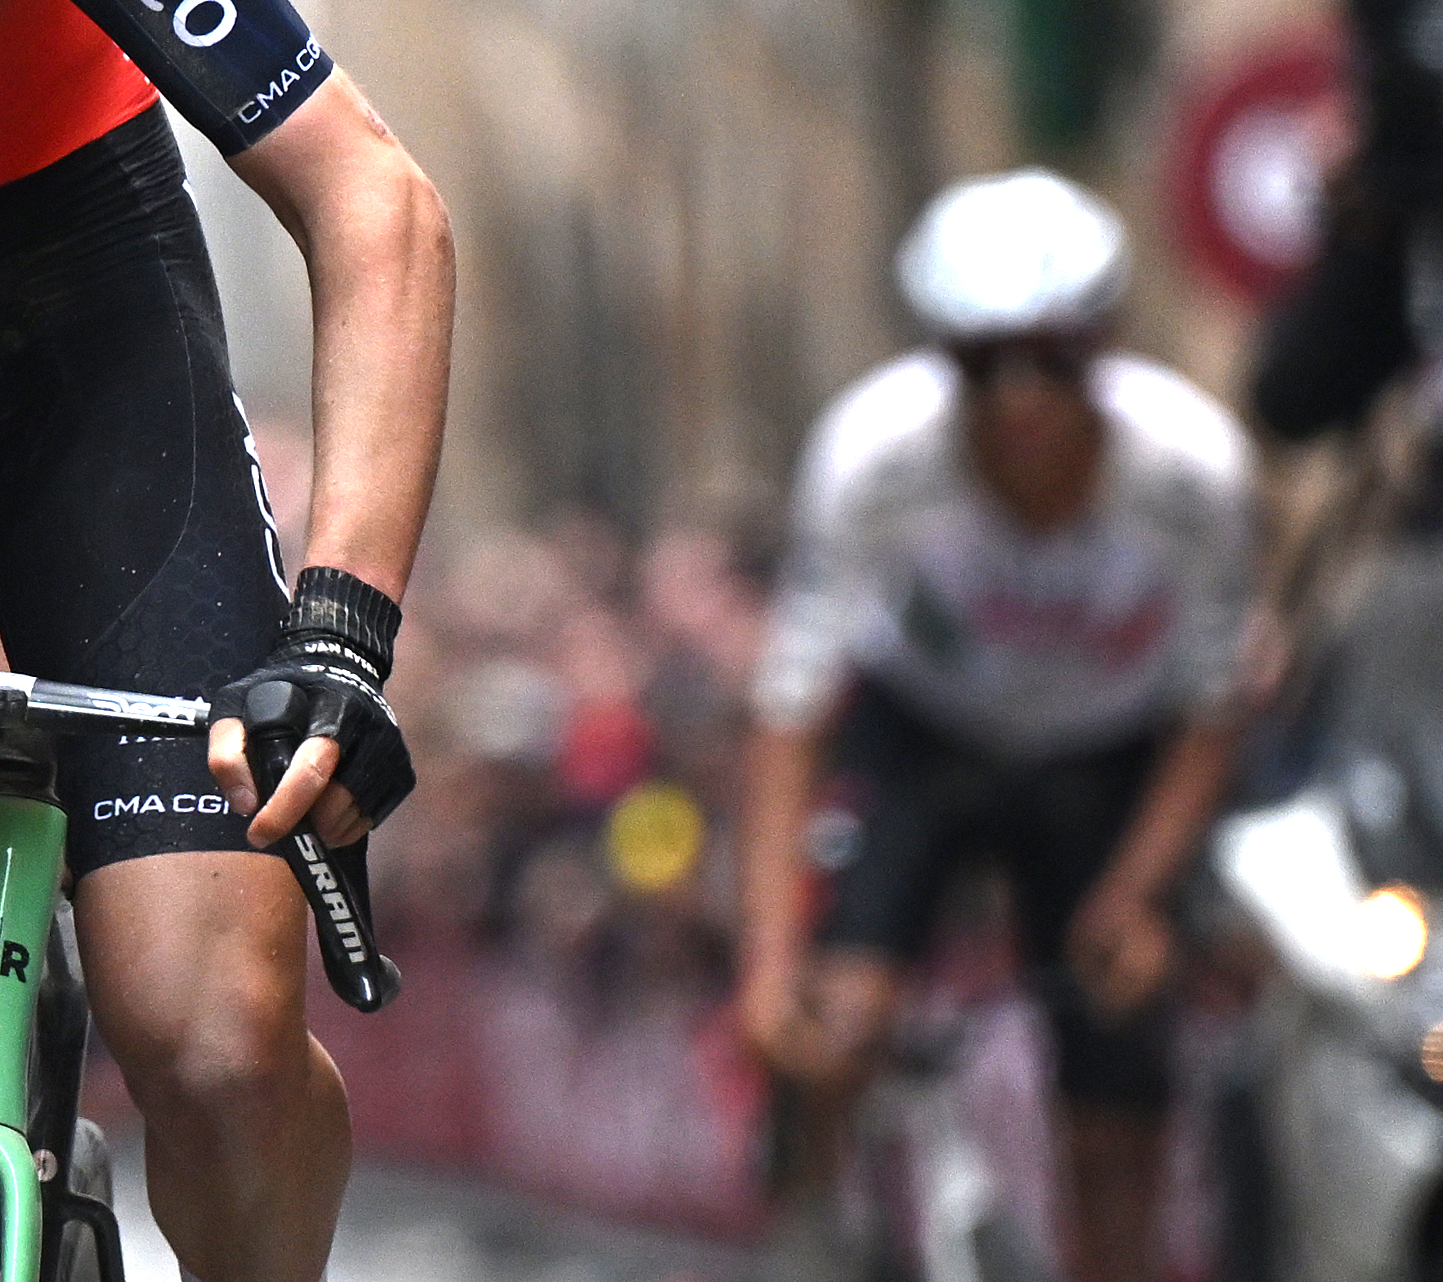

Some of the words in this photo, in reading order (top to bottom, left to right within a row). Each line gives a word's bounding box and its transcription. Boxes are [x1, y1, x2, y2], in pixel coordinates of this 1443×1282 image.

[237, 69, 301, 124] CMA
[296, 32, 321, 72] CG
[94, 794, 166, 821] CMA
[172, 793, 230, 816] CG
[294, 832, 365, 964] SRAM
